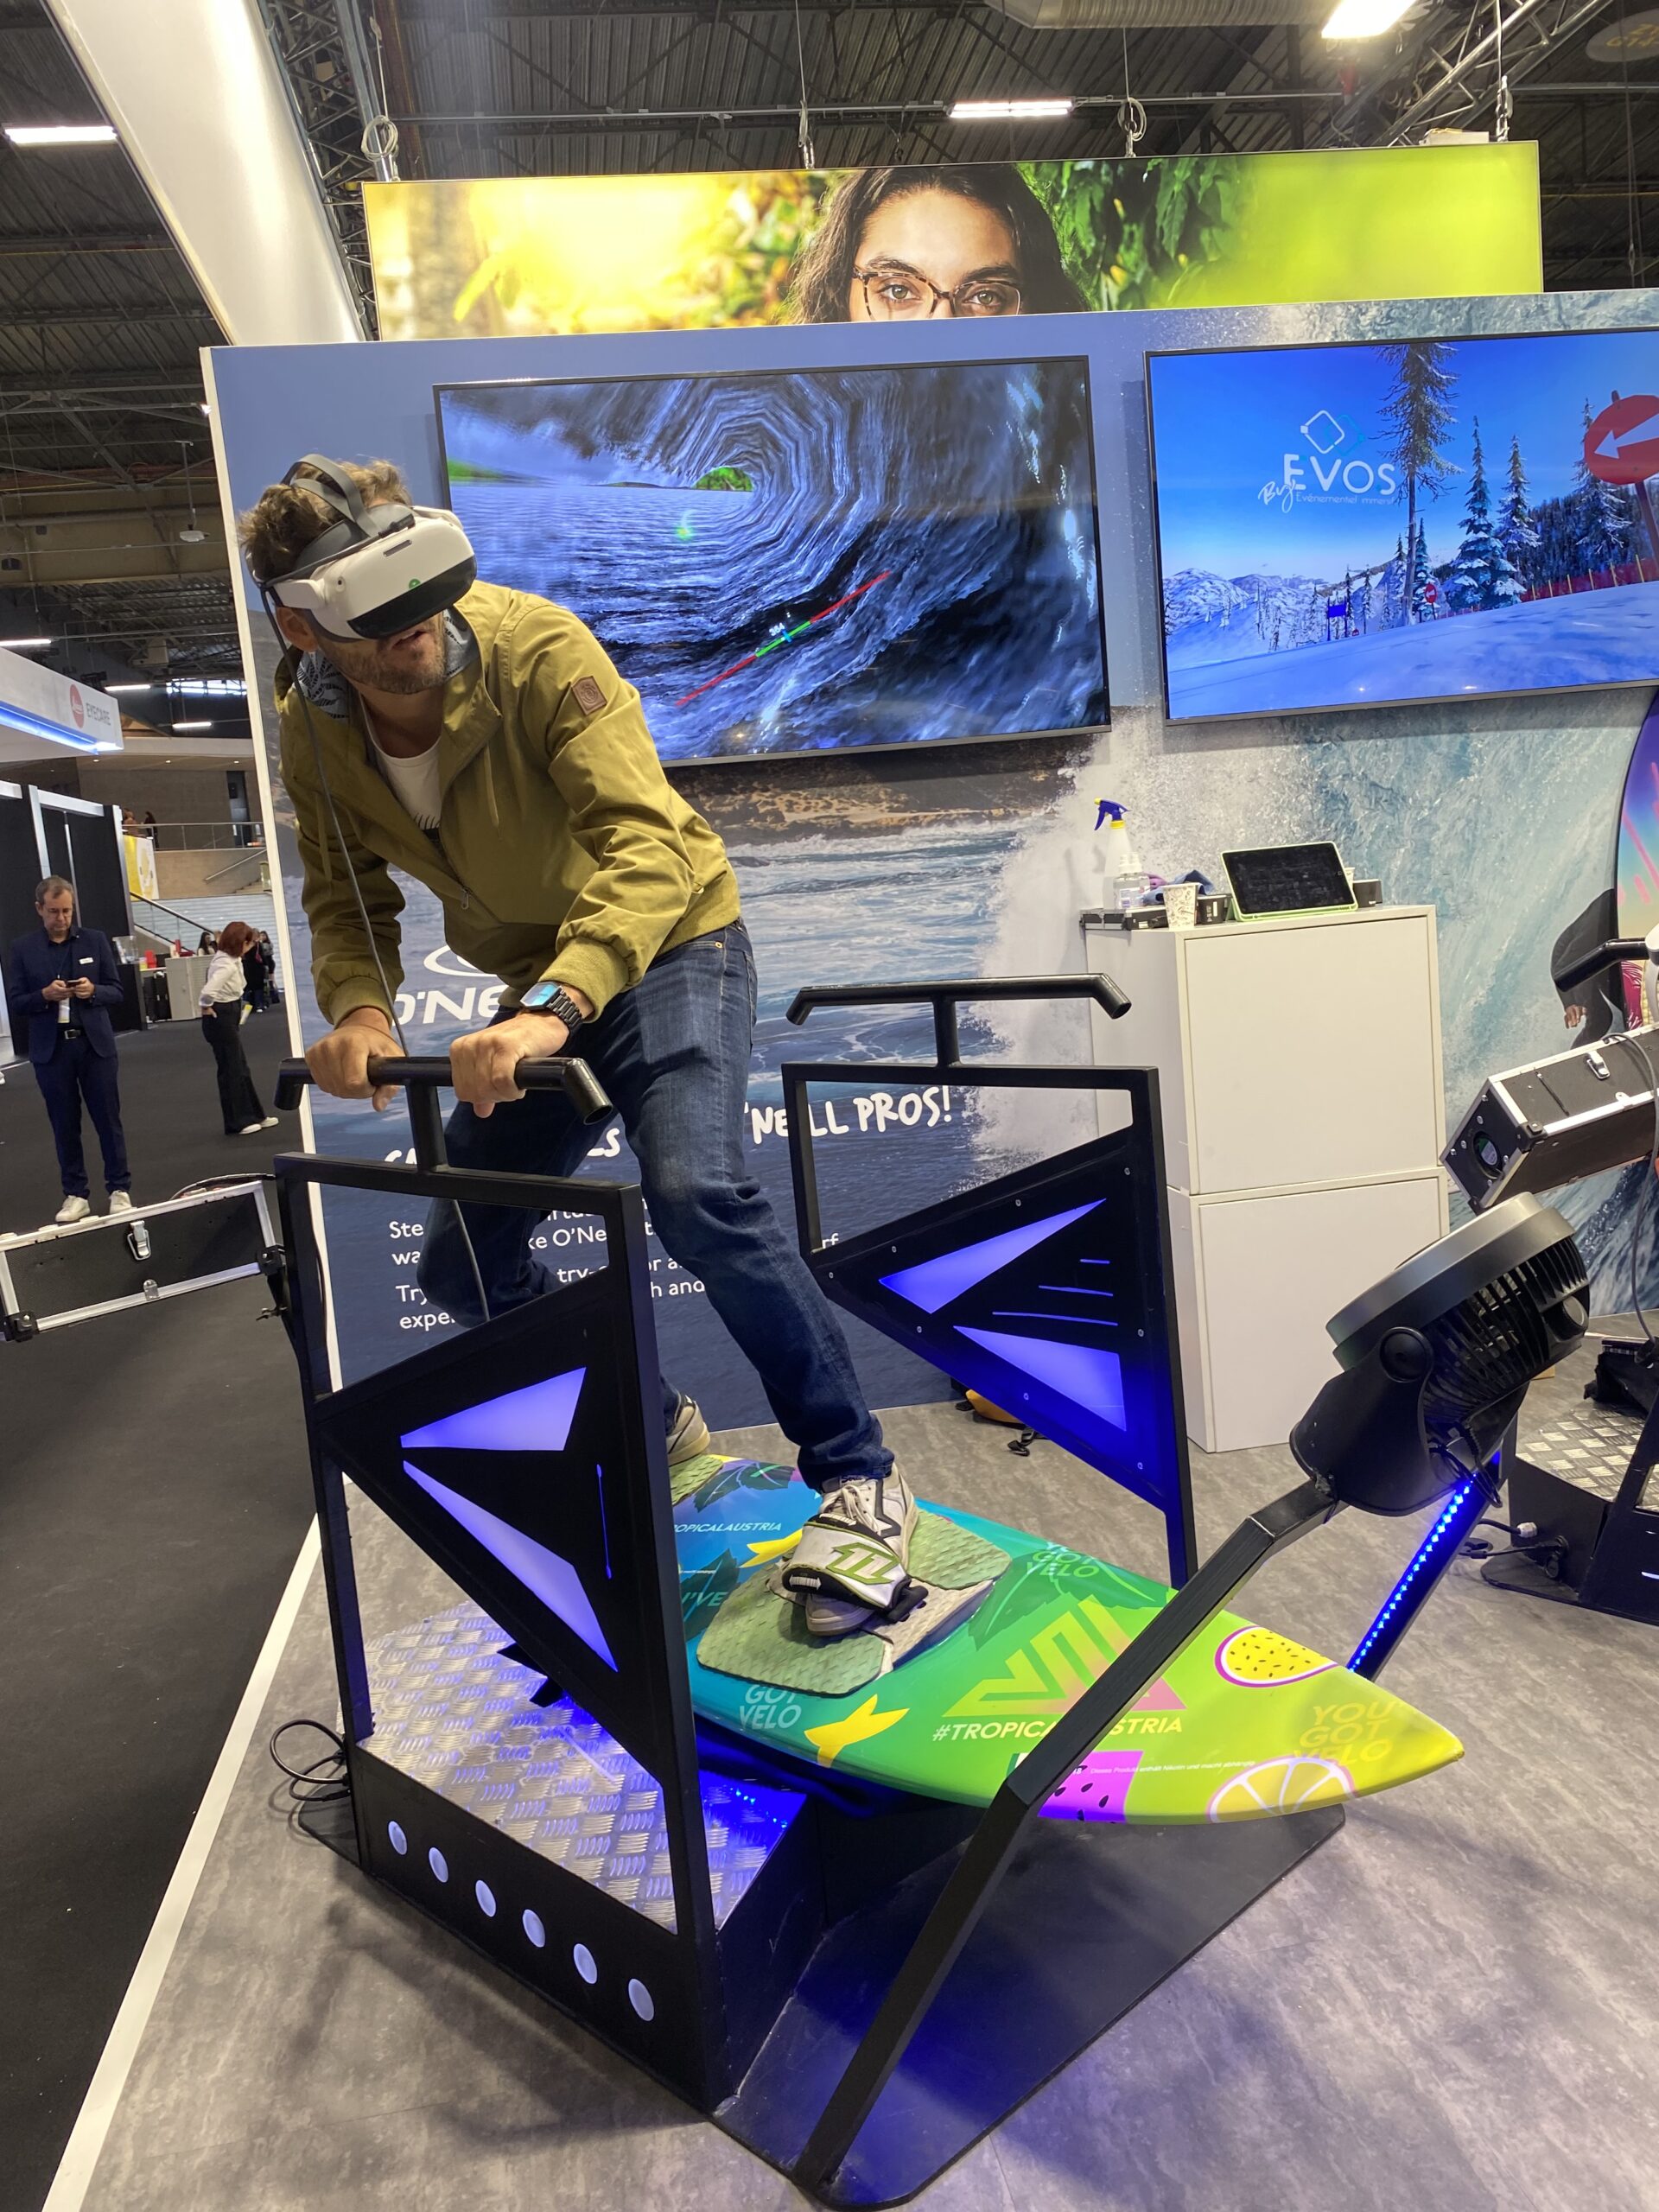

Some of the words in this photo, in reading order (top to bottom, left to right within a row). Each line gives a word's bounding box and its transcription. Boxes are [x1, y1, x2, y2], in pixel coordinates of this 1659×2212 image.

[1284, 454, 1396, 495] EVOS
[853, 1085, 952, 1133] PROS!
[739, 1704, 802, 1730] VELO
[1313, 1700, 1396, 1726] YOU
[1299, 1718, 1390, 1748] GOT
